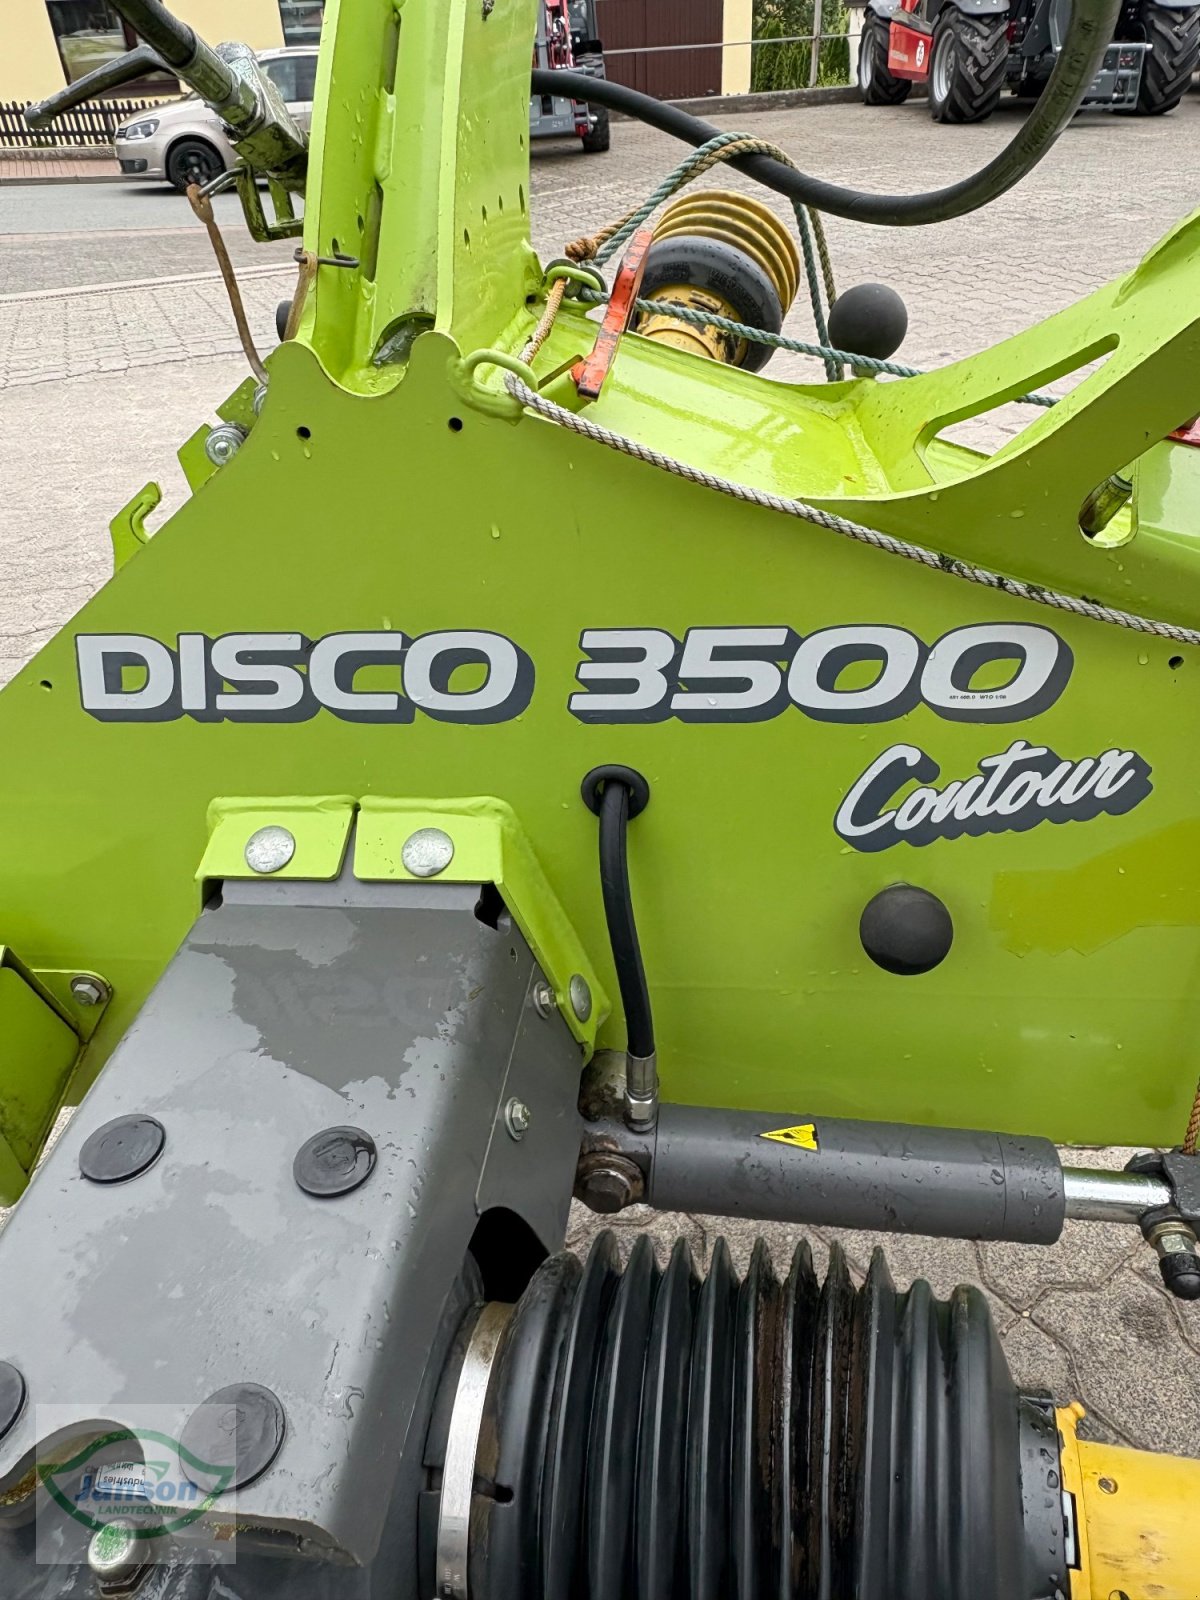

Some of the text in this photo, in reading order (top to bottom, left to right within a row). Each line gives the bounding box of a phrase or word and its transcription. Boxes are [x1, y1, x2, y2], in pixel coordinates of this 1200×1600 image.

[76, 623, 1064, 714] DISCO 3500
[835, 740, 1143, 844] Contour
